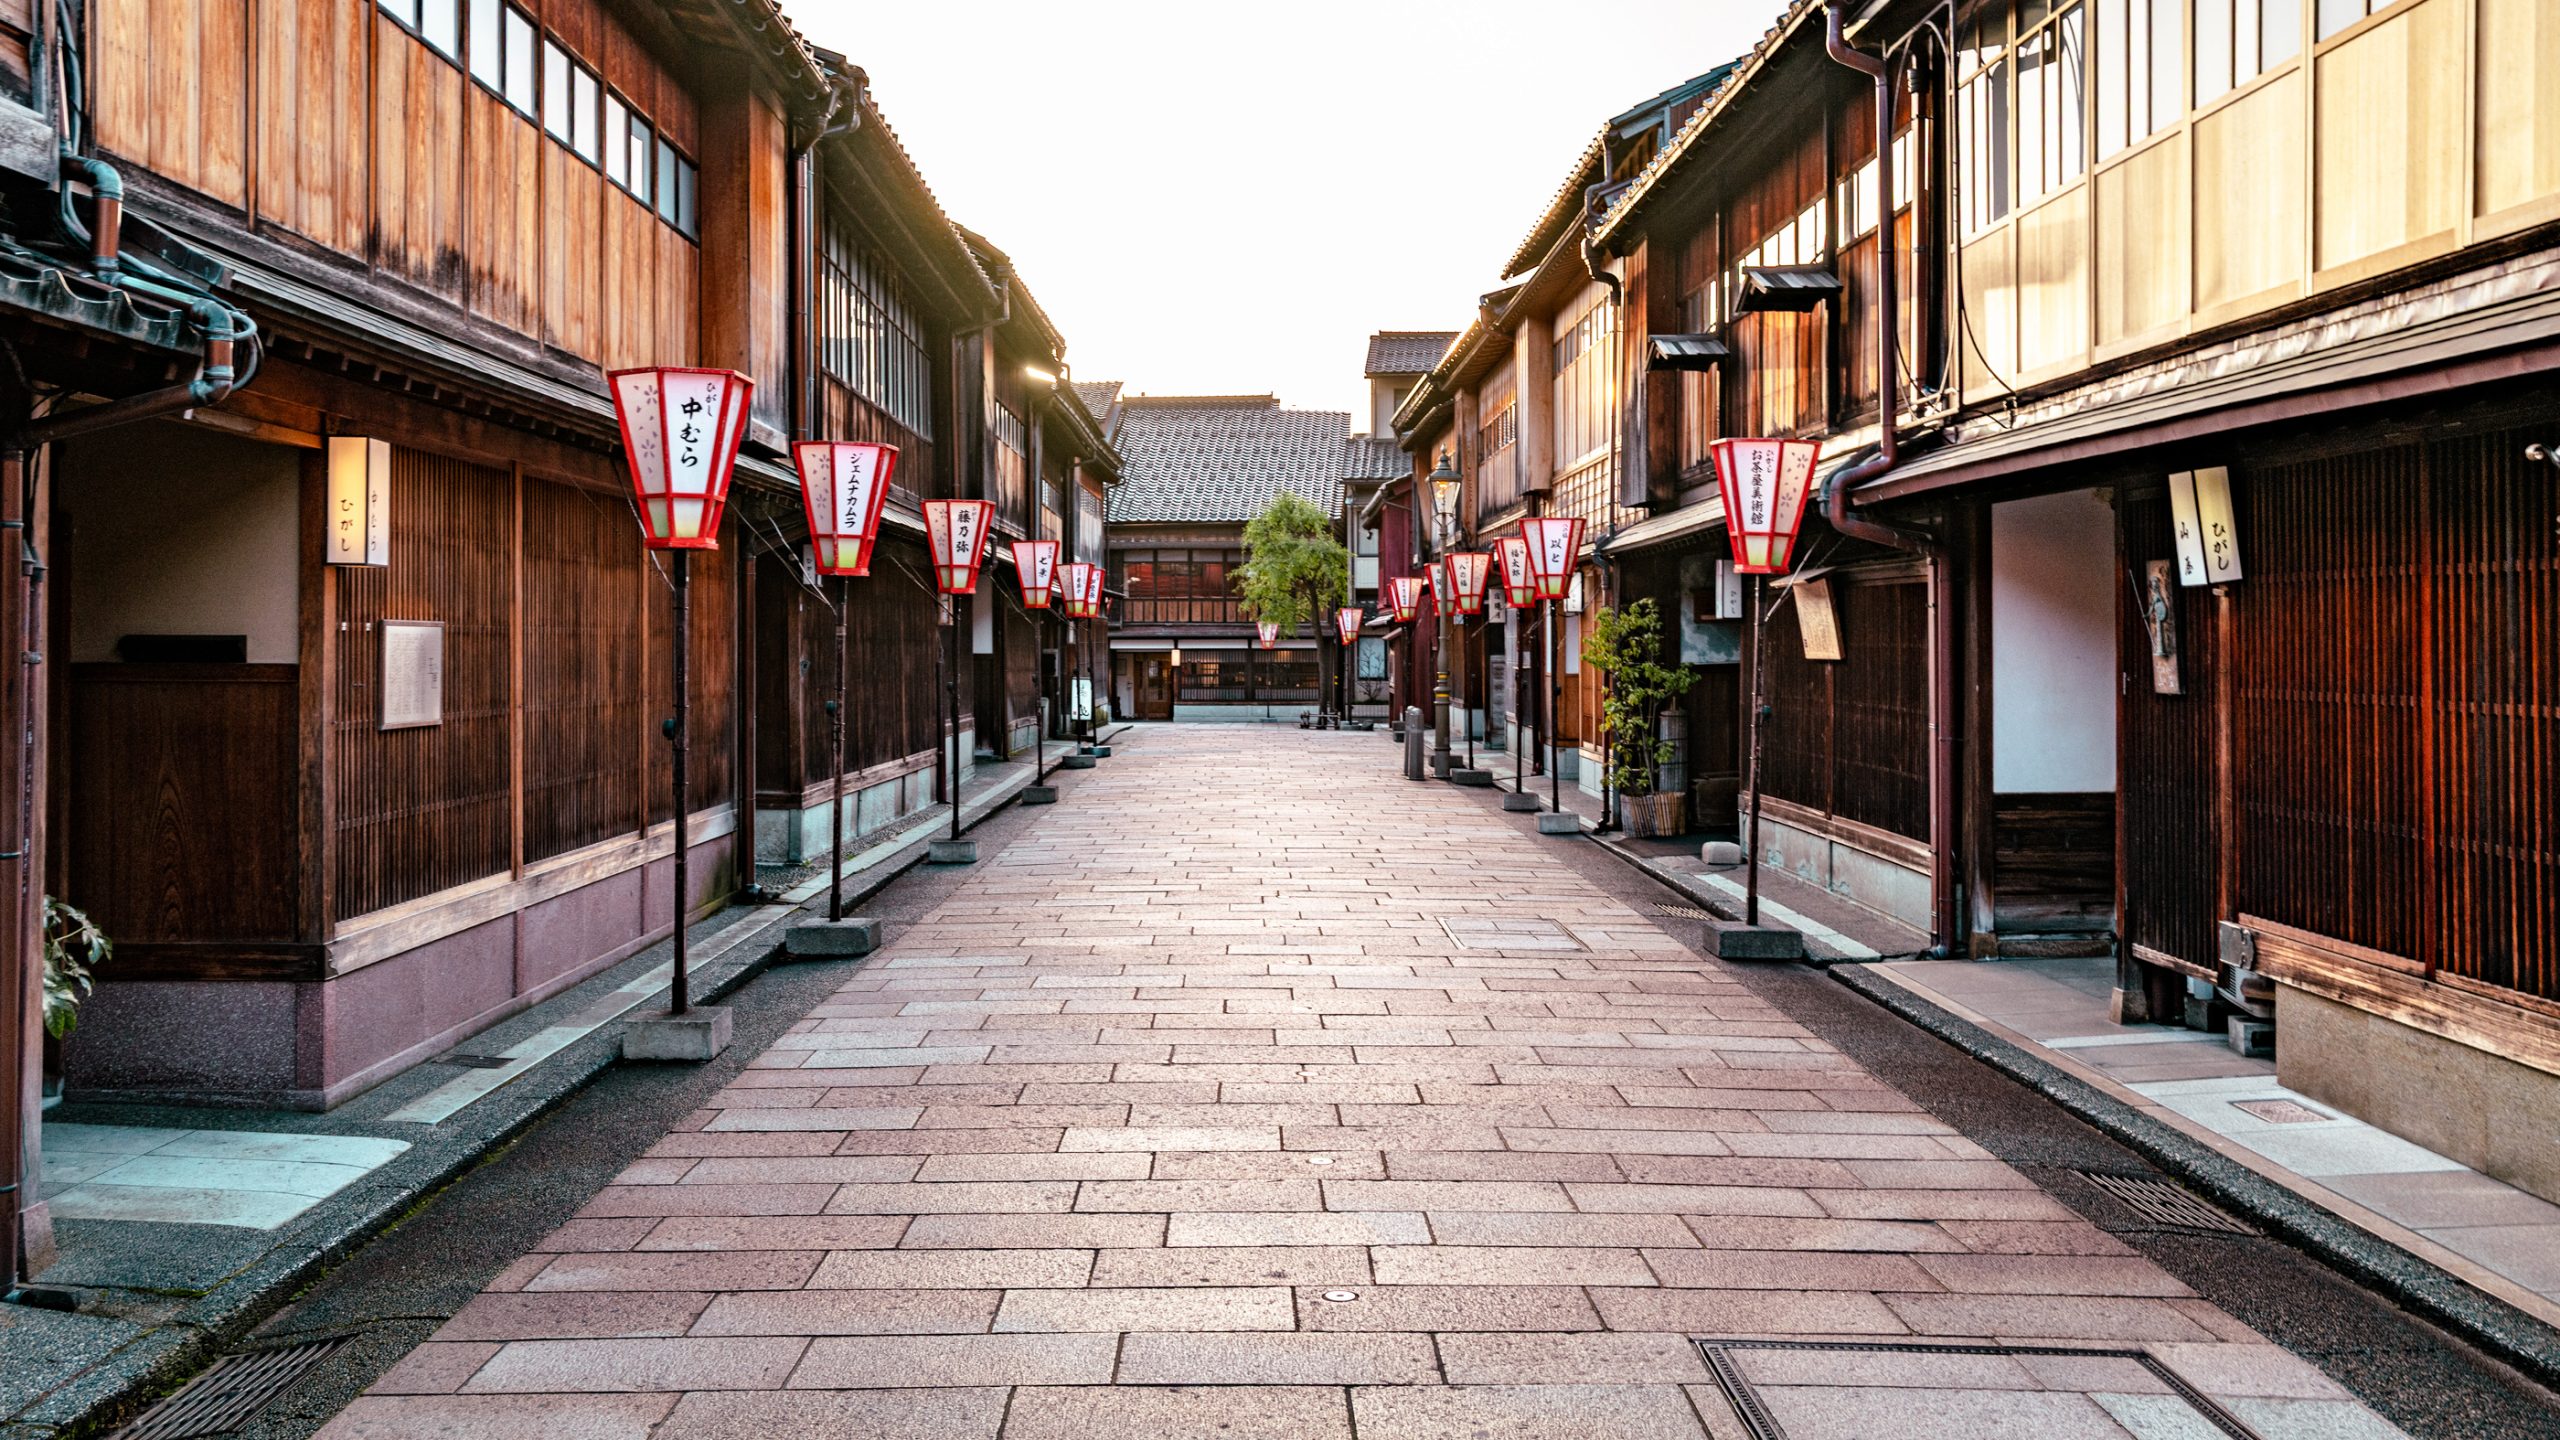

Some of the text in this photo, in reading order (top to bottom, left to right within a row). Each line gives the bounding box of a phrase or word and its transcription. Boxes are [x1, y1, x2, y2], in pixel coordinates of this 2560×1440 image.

[705, 382, 717, 418] ひがし
[680, 396, 703, 468] 中むら
[1766, 449, 1774, 473] ひがし
[844, 452, 862, 529] ジェムナカムラ
[1751, 449, 1764, 525] お茶屋美術館
[340, 498, 354, 552] ひがし
[956, 510, 971, 553] 藤乃弥
[2212, 522, 2230, 571] ひがし
[1511, 548, 1520, 577] 福太郎
